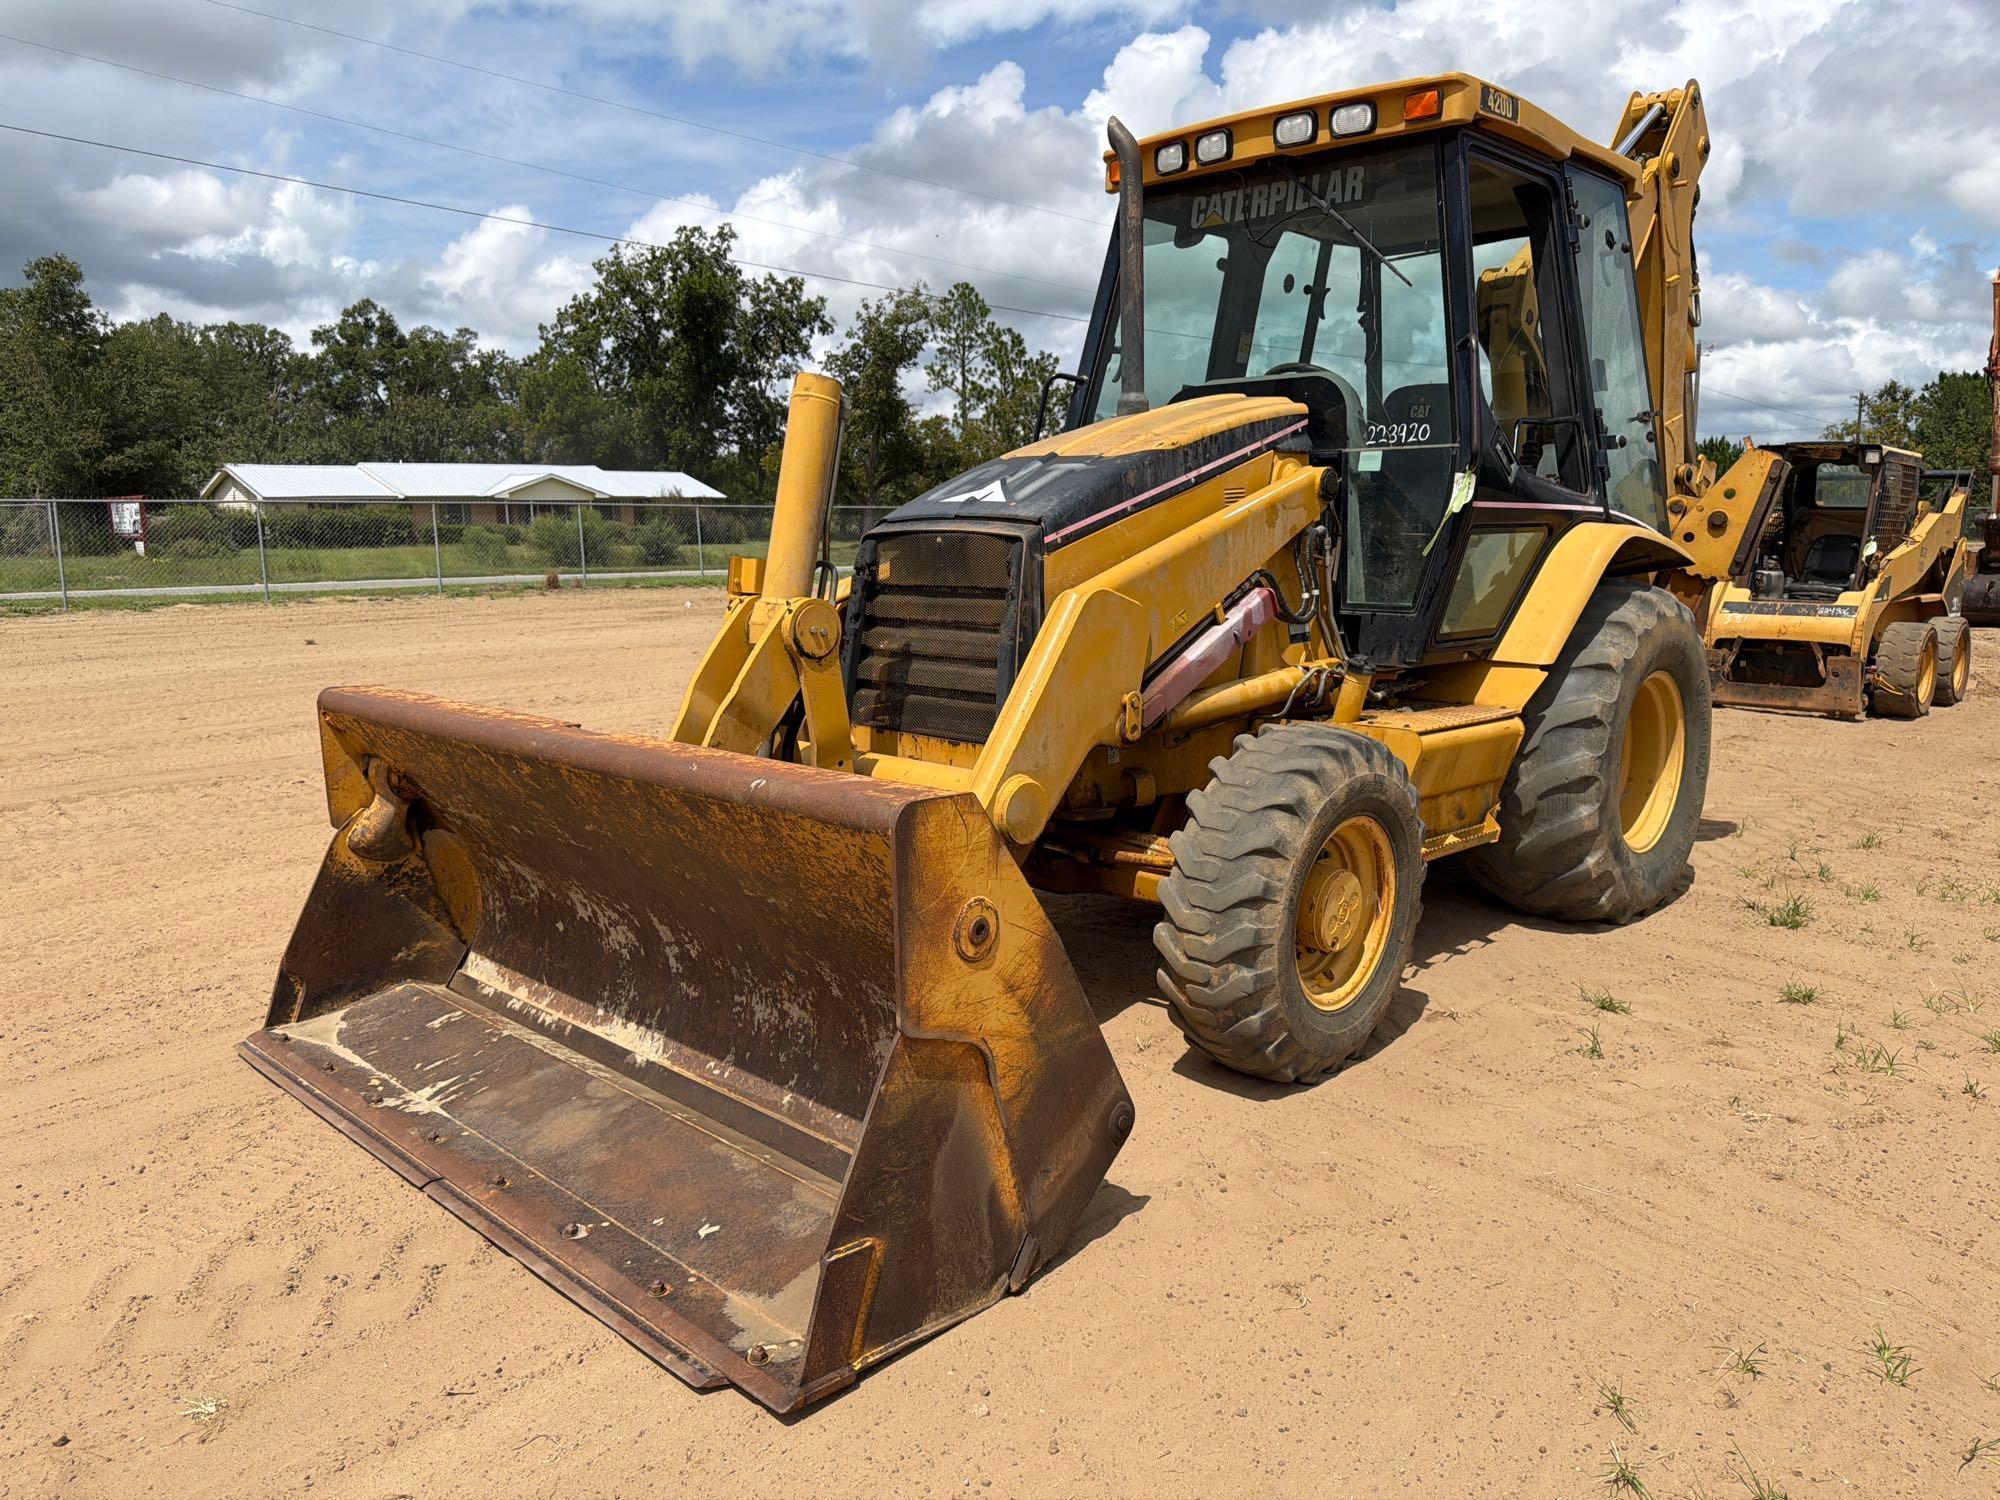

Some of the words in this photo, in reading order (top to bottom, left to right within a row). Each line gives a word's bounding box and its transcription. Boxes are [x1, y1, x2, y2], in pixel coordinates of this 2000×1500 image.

[1190, 165, 1366, 229] CATERPILLAR
[1410, 404, 1432, 418] CAT
[1365, 422, 1431, 446] 223920
